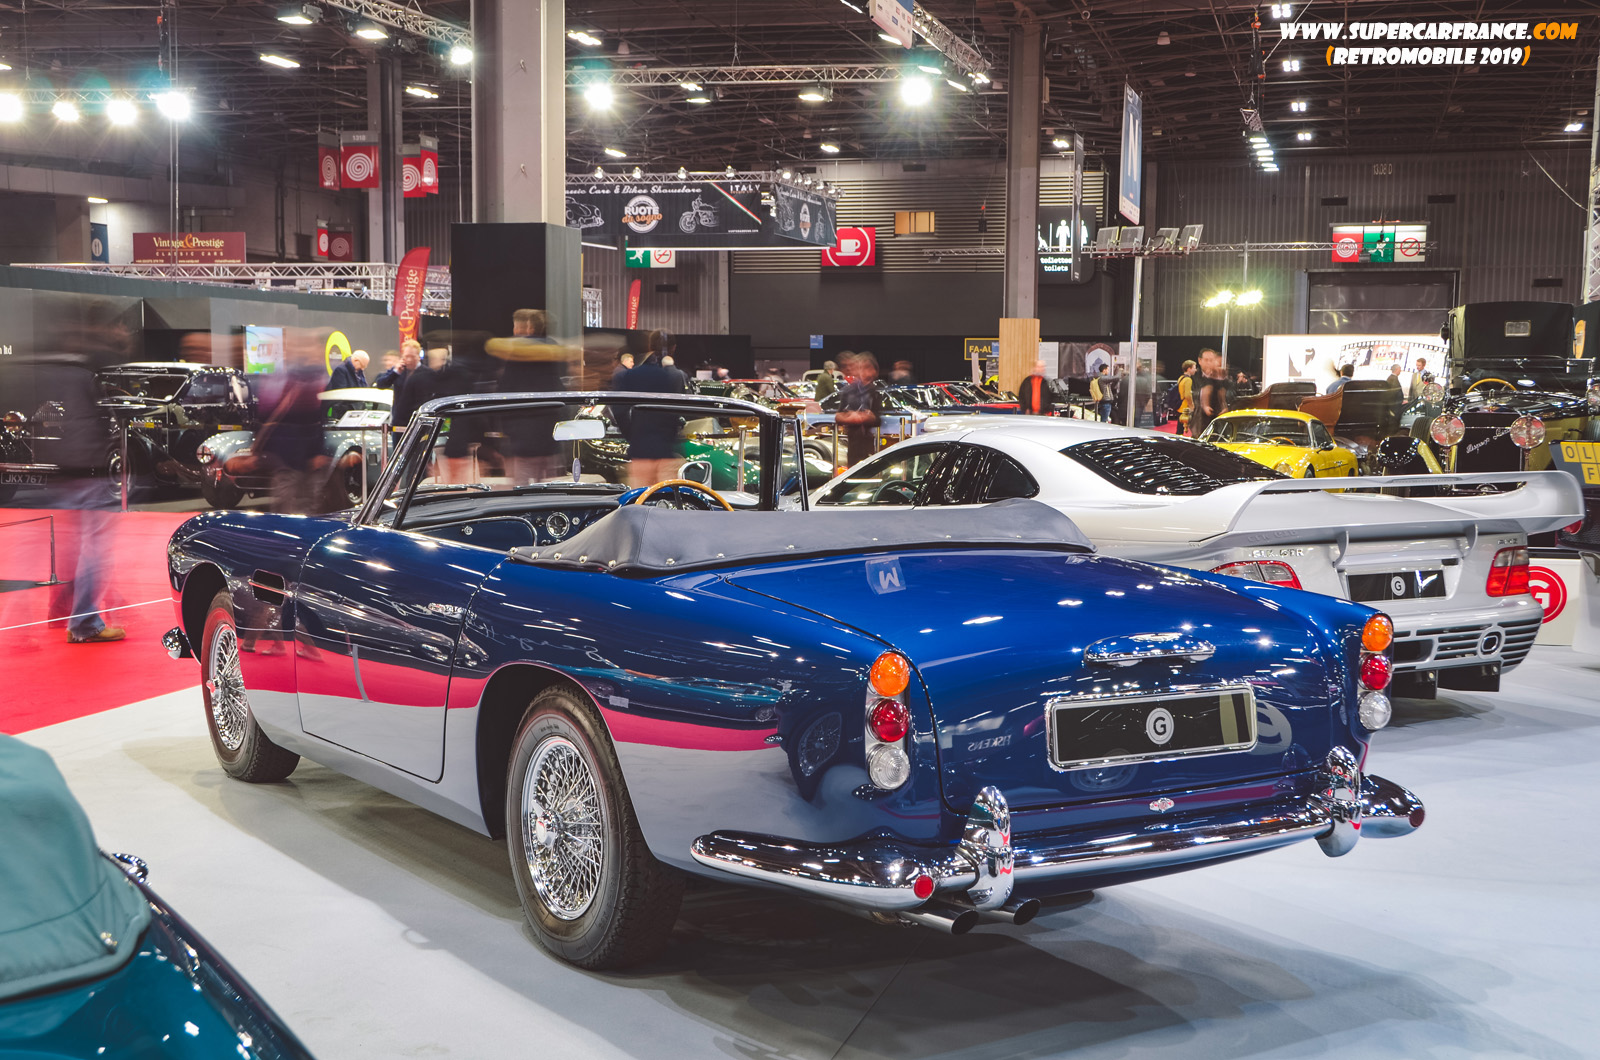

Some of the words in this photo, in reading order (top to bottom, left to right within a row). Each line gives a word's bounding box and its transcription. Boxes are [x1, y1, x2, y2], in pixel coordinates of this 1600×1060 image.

[1127, 111, 1139, 182] N
[624, 206, 660, 216] RUOTE
[635, 213, 663, 225] sogno
[153, 236, 184, 248] Vintage
[192, 237, 225, 248] Prestige
[400, 269, 421, 320] Prestige
[5, 474, 23, 483] JKX
[25, 474, 43, 484] 767
[1152, 716, 1168, 737] G
